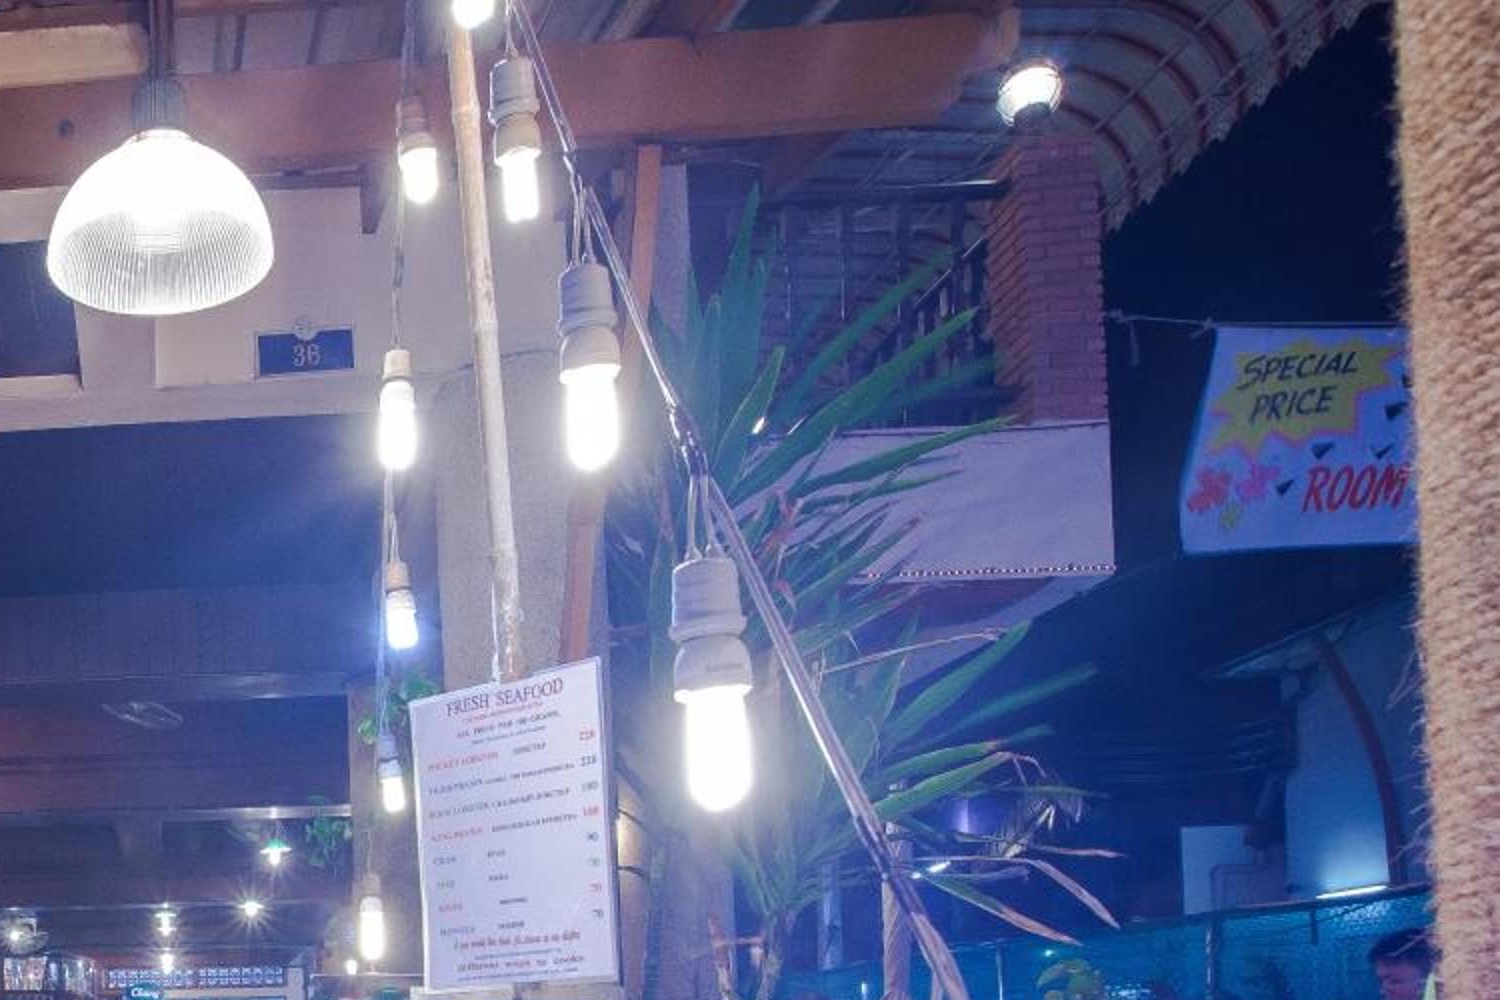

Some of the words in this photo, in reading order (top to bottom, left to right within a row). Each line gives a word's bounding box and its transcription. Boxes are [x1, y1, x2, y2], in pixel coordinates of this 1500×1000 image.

[291, 342, 322, 369] 36
[1237, 350, 1359, 391] SPECIAL
[1249, 384, 1338, 425] PRICE
[445, 695, 490, 717] FRESH
[493, 677, 564, 707] SEAFOOD
